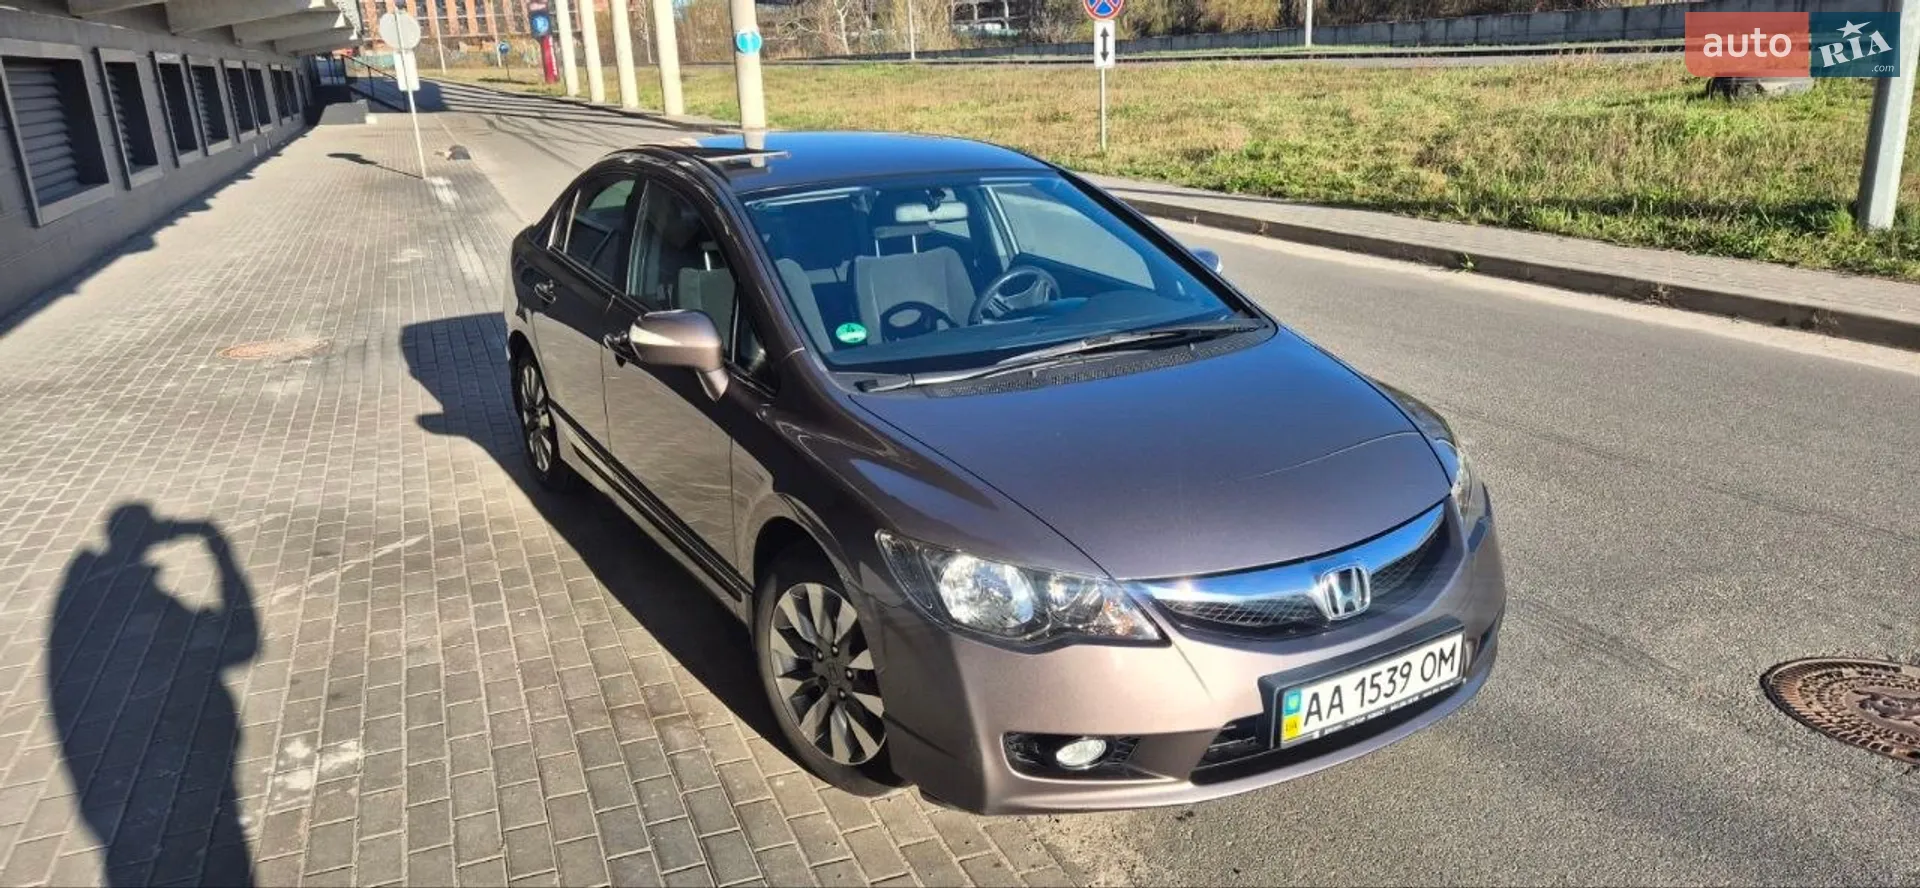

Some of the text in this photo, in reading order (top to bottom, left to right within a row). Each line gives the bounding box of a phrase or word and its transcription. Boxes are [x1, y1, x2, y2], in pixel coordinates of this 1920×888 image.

[1303, 685, 1344, 726] AA
[1354, 661, 1413, 708] 1539
[1420, 643, 1456, 682] OM
